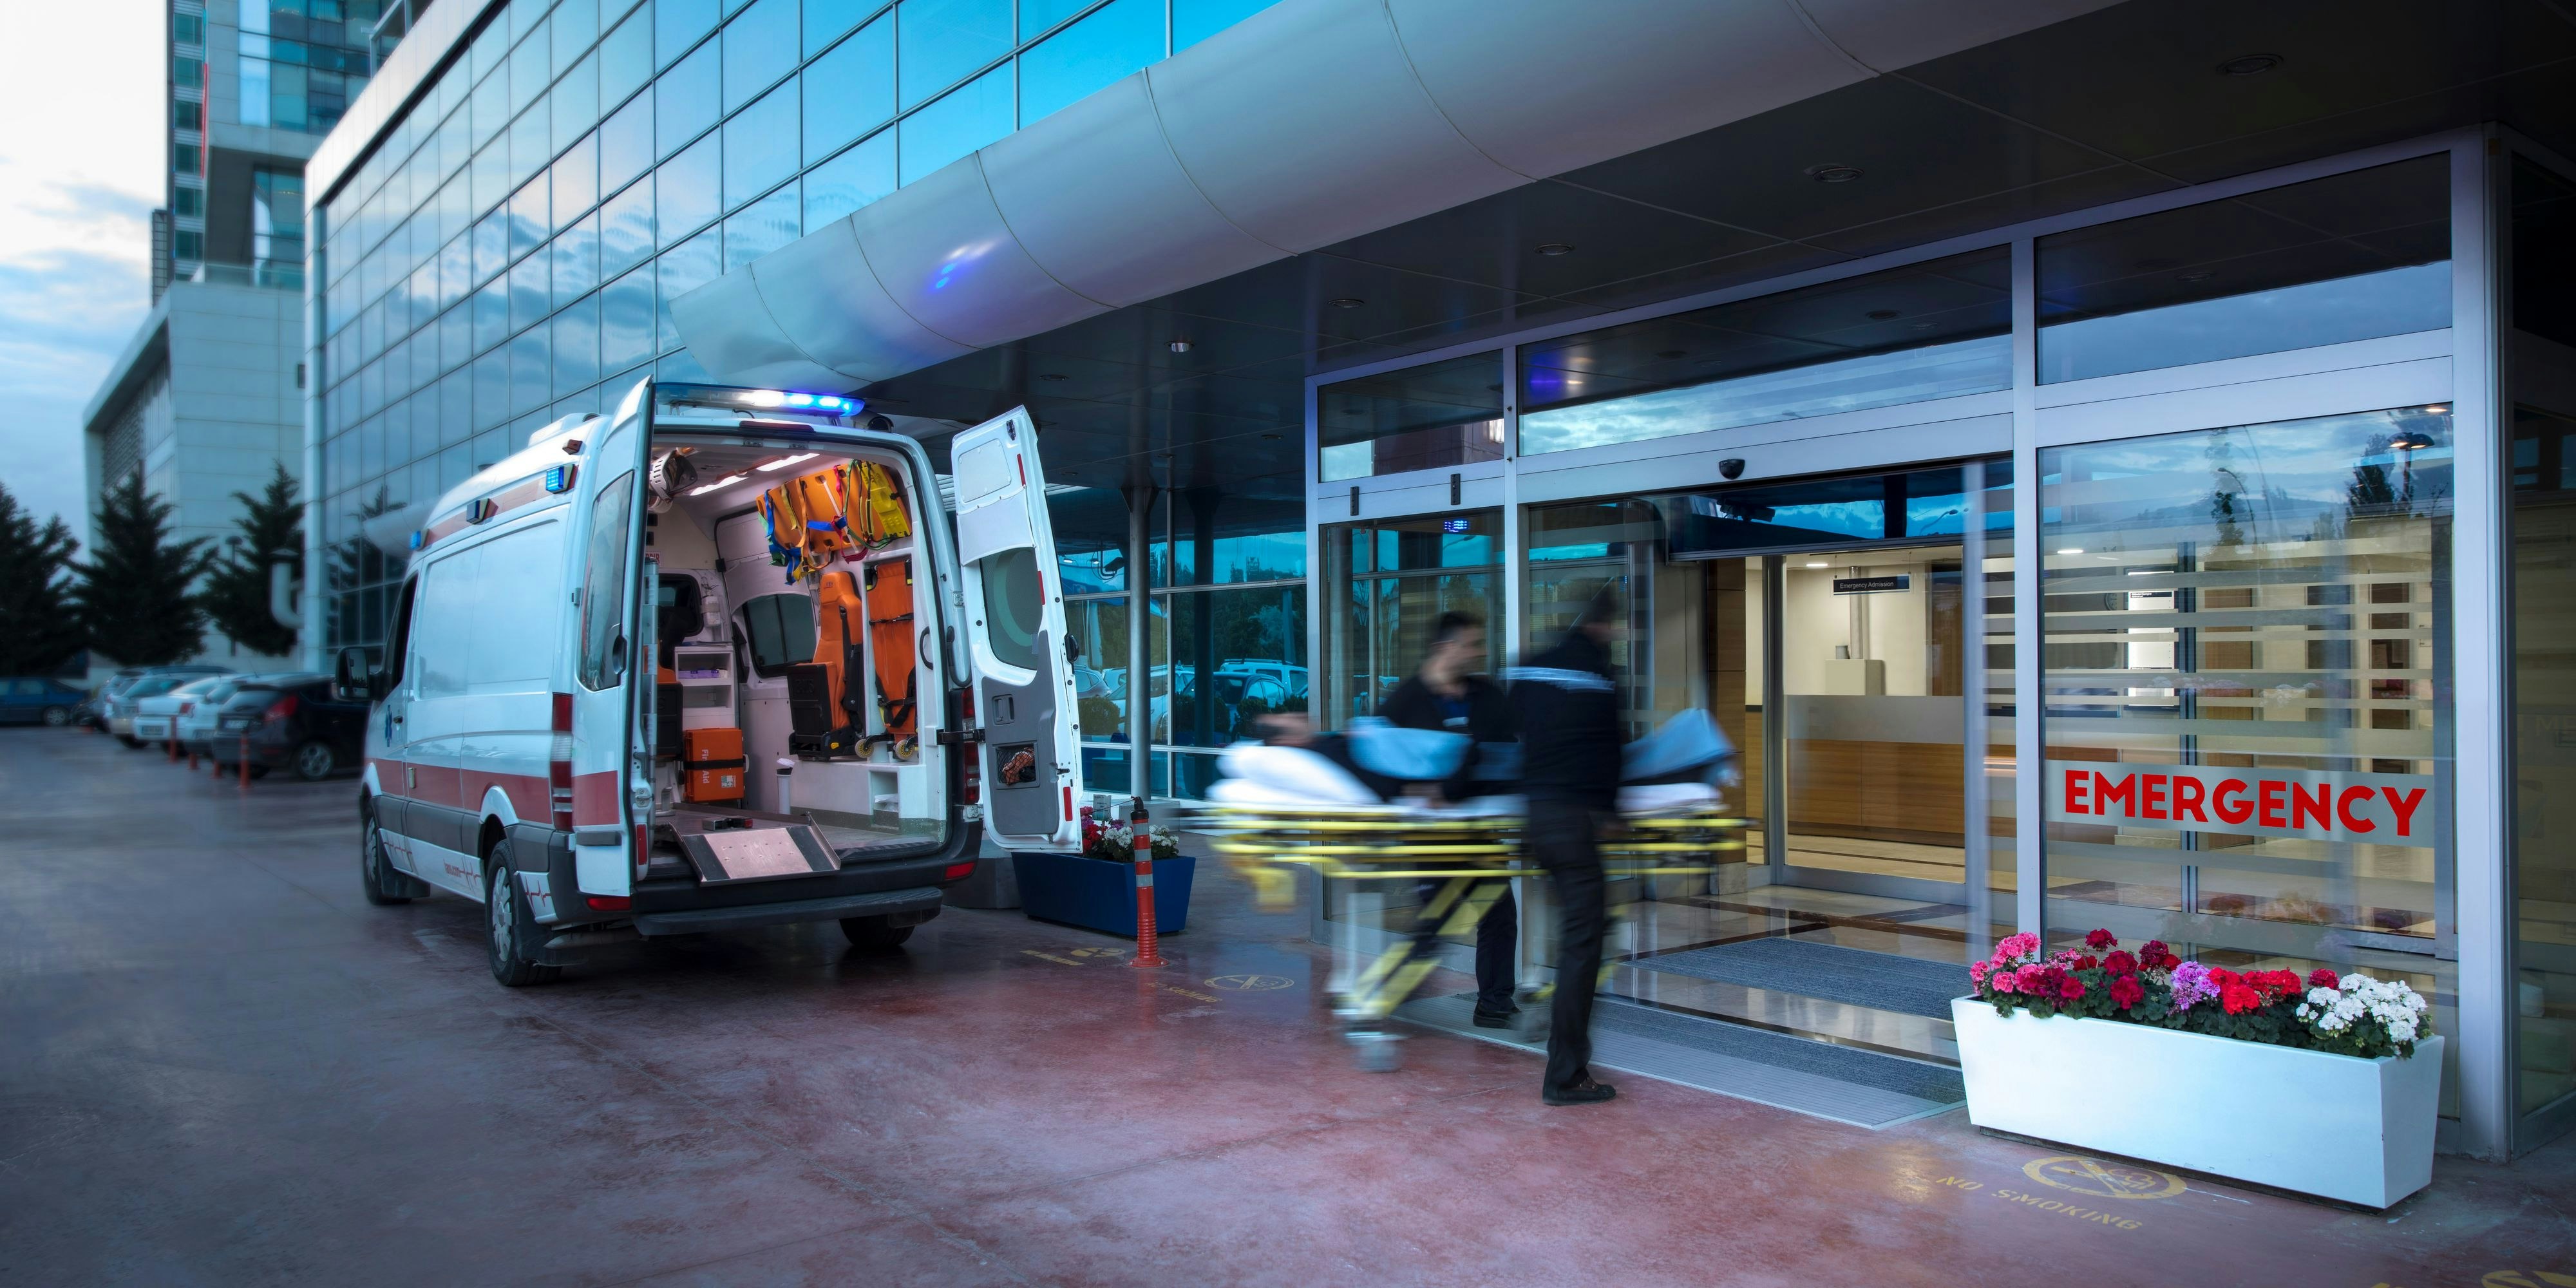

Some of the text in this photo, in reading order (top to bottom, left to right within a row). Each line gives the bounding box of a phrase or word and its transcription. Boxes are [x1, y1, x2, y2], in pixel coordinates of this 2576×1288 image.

[2065, 770, 2426, 837] EMERGENCY
[1163, 986, 1223, 1003] SMOKING
[1935, 1175, 2143, 1230] NO SMOKING
